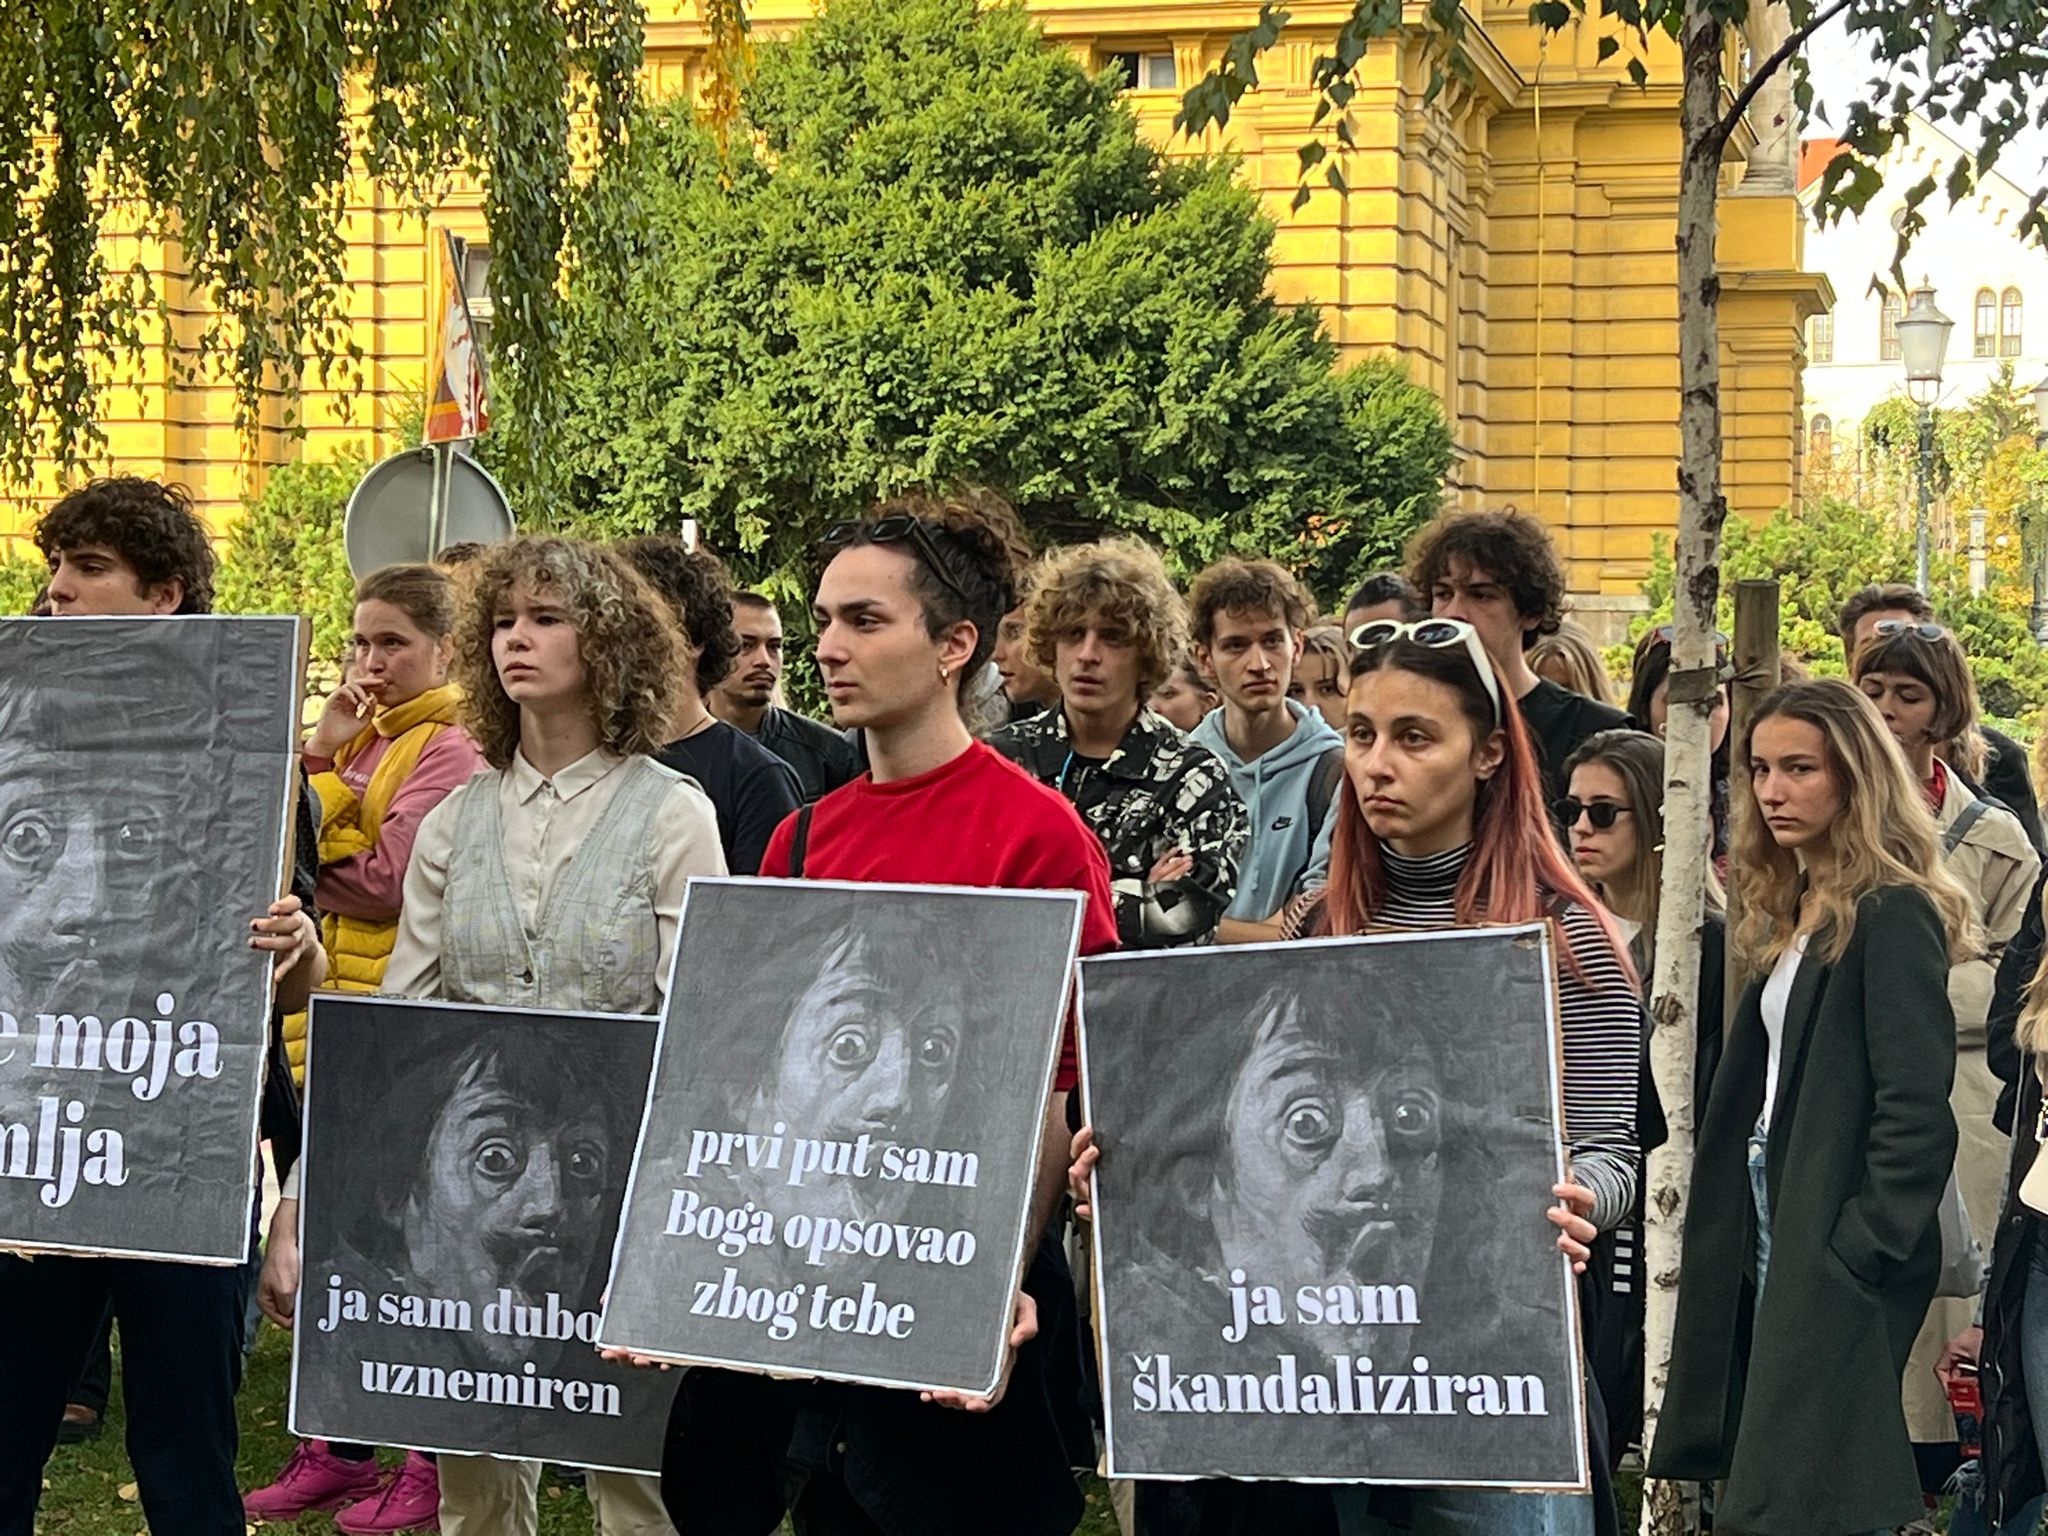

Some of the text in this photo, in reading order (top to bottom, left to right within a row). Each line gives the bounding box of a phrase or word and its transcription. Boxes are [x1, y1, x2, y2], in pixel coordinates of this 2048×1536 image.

[31, 993, 224, 1101] moja
[683, 1121, 979, 1188] prvi put sam
[662, 1189, 976, 1266] Boga opsovao
[317, 1274, 370, 1332] ja
[378, 1293, 473, 1331] sam
[690, 1267, 915, 1341] zbog tebe
[1222, 1268, 1421, 1343] ja sam
[360, 1360, 621, 1416] uznemiren
[1132, 1353, 1549, 1416] škandaliziran
